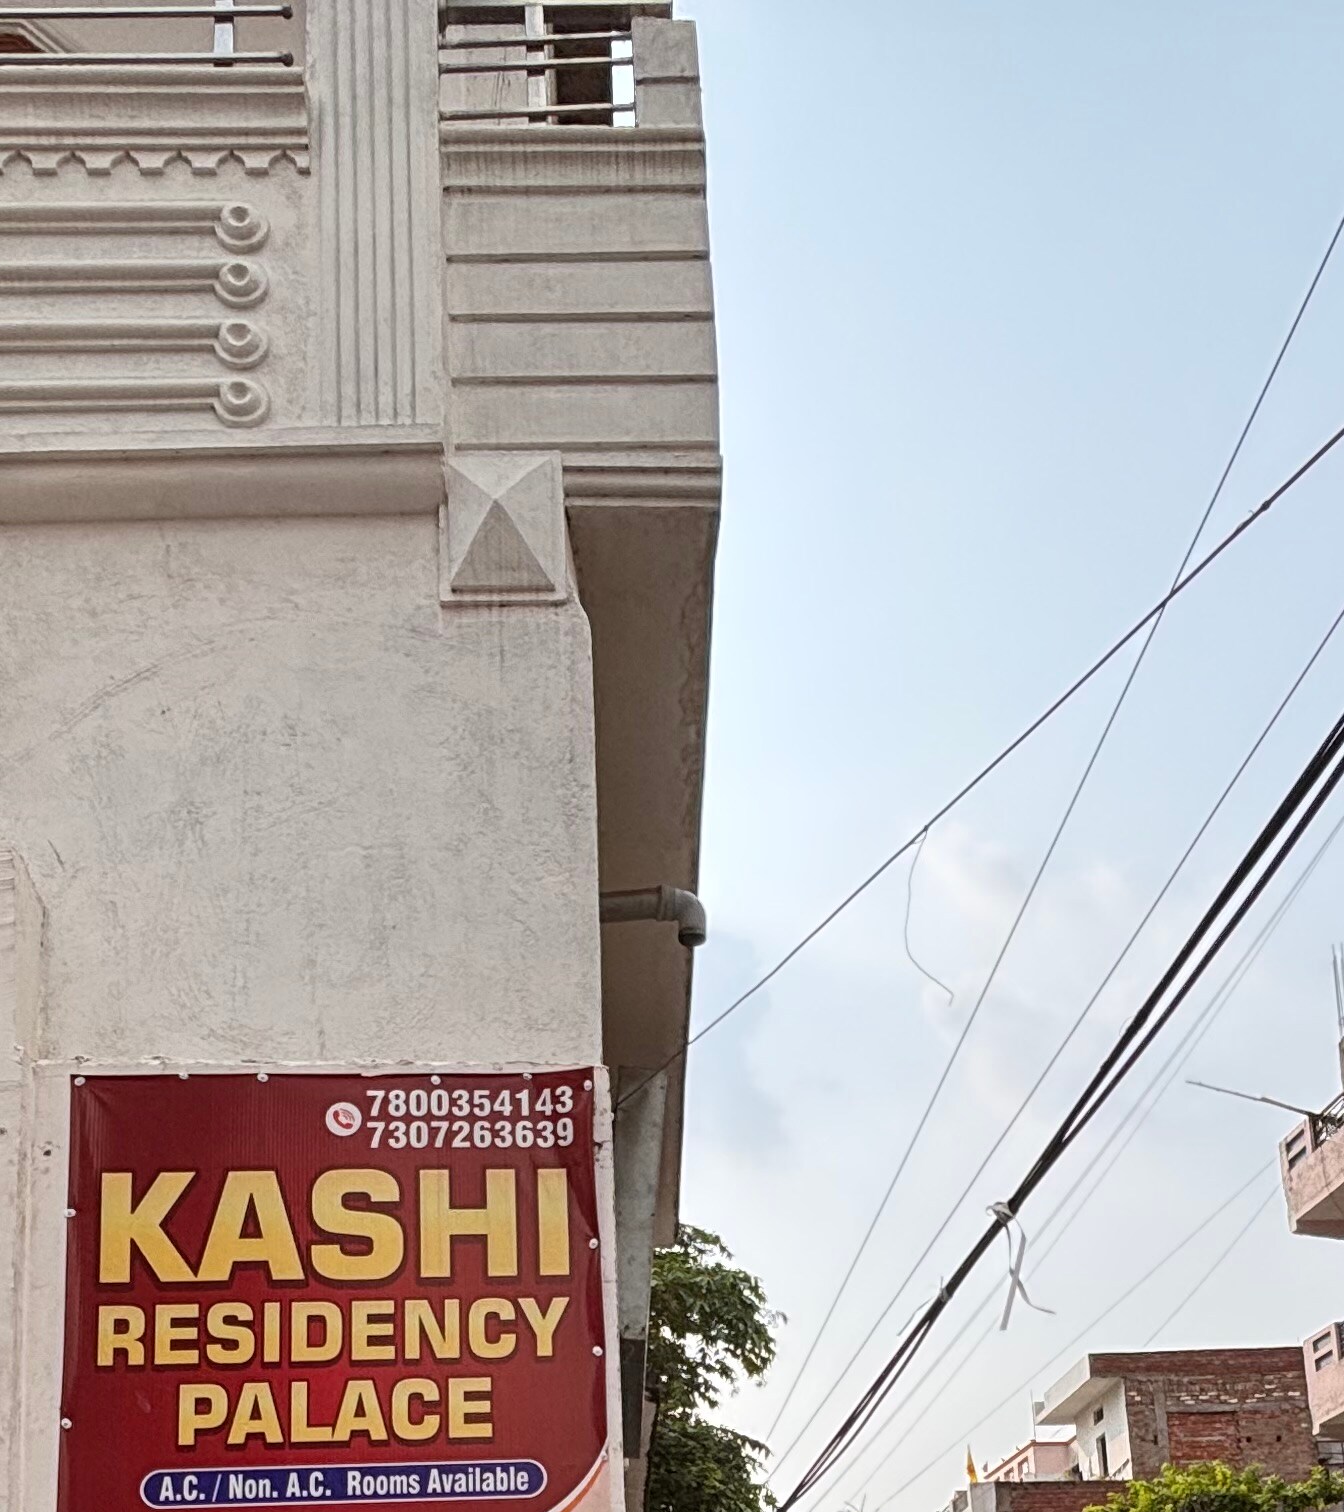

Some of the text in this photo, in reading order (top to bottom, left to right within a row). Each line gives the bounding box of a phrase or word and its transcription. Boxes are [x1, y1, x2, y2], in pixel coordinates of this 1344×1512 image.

[366, 1086, 574, 1119] 7800354143
[367, 1117, 574, 1149] 7307263639
[99, 1168, 570, 1283] KASHI
[96, 1297, 570, 1367] RESIDENCY
[177, 1377, 493, 1446] PALACE
[159, 1476, 206, 1503] A.C.
[228, 1474, 280, 1501] Non.
[286, 1472, 332, 1498] A.C.
[347, 1469, 421, 1497] Rooms
[427, 1464, 529, 1494] Available
